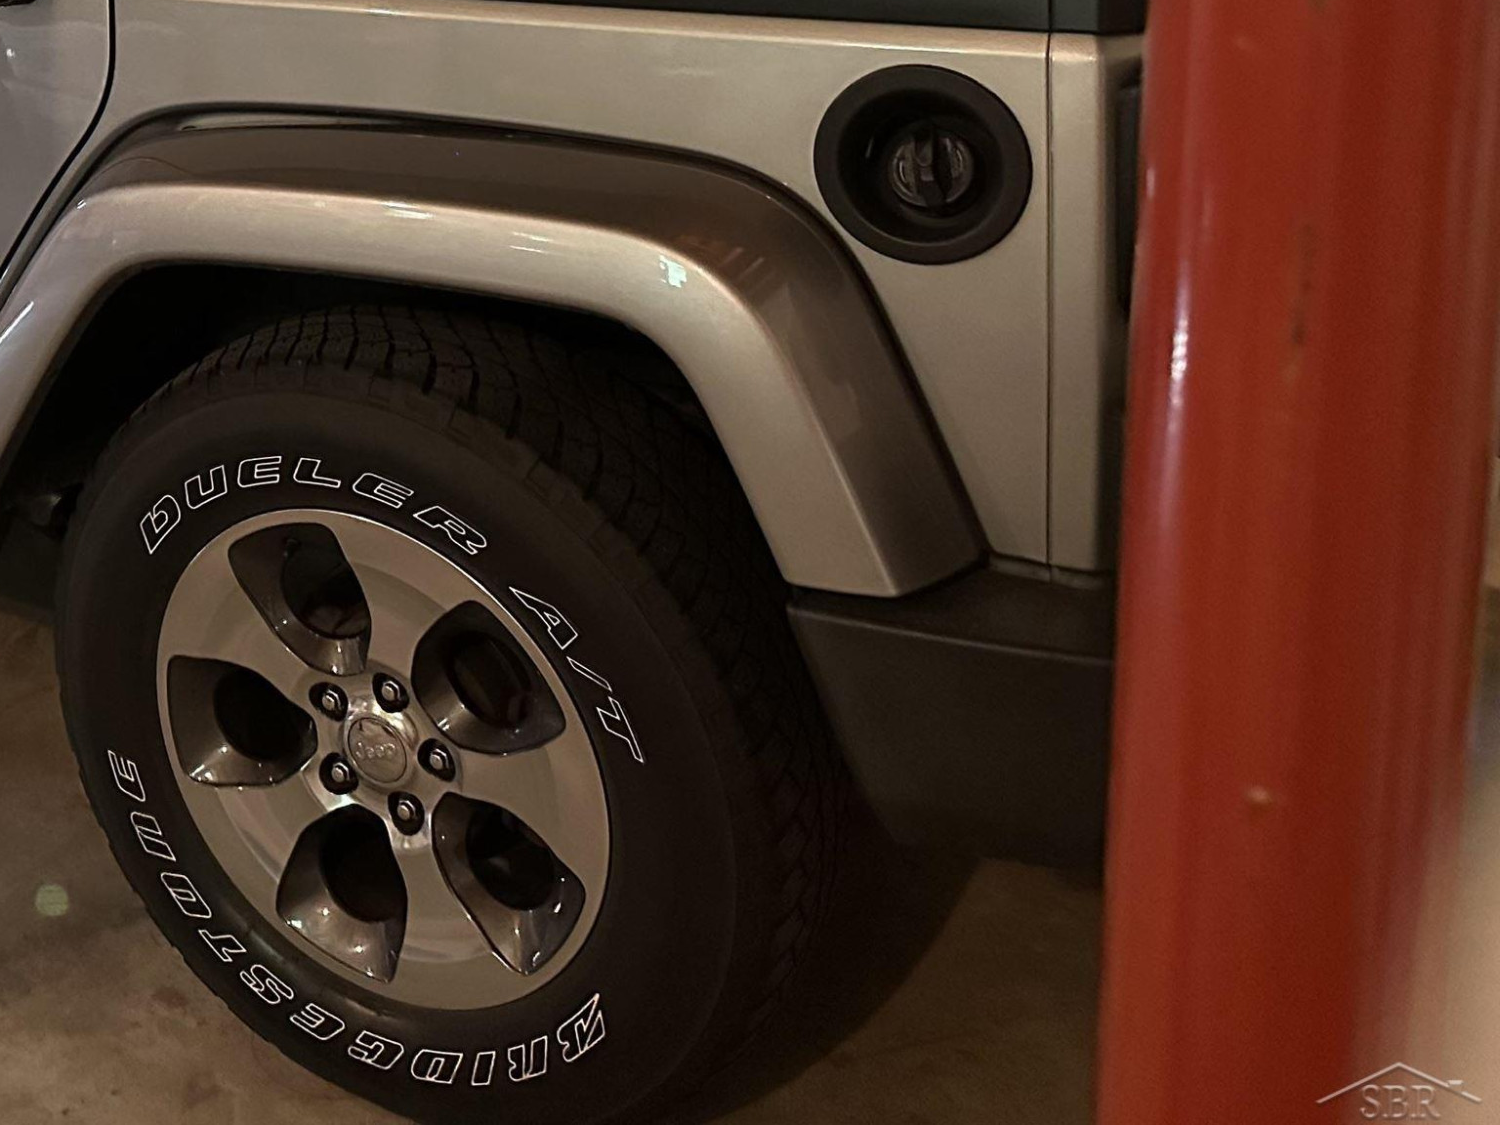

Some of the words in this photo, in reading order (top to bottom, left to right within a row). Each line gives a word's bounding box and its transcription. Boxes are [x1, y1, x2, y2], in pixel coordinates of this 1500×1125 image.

[140, 455, 488, 556] DUELER
[508, 586, 646, 764] A/T
[109, 749, 605, 1088] BRIDGESTONE
